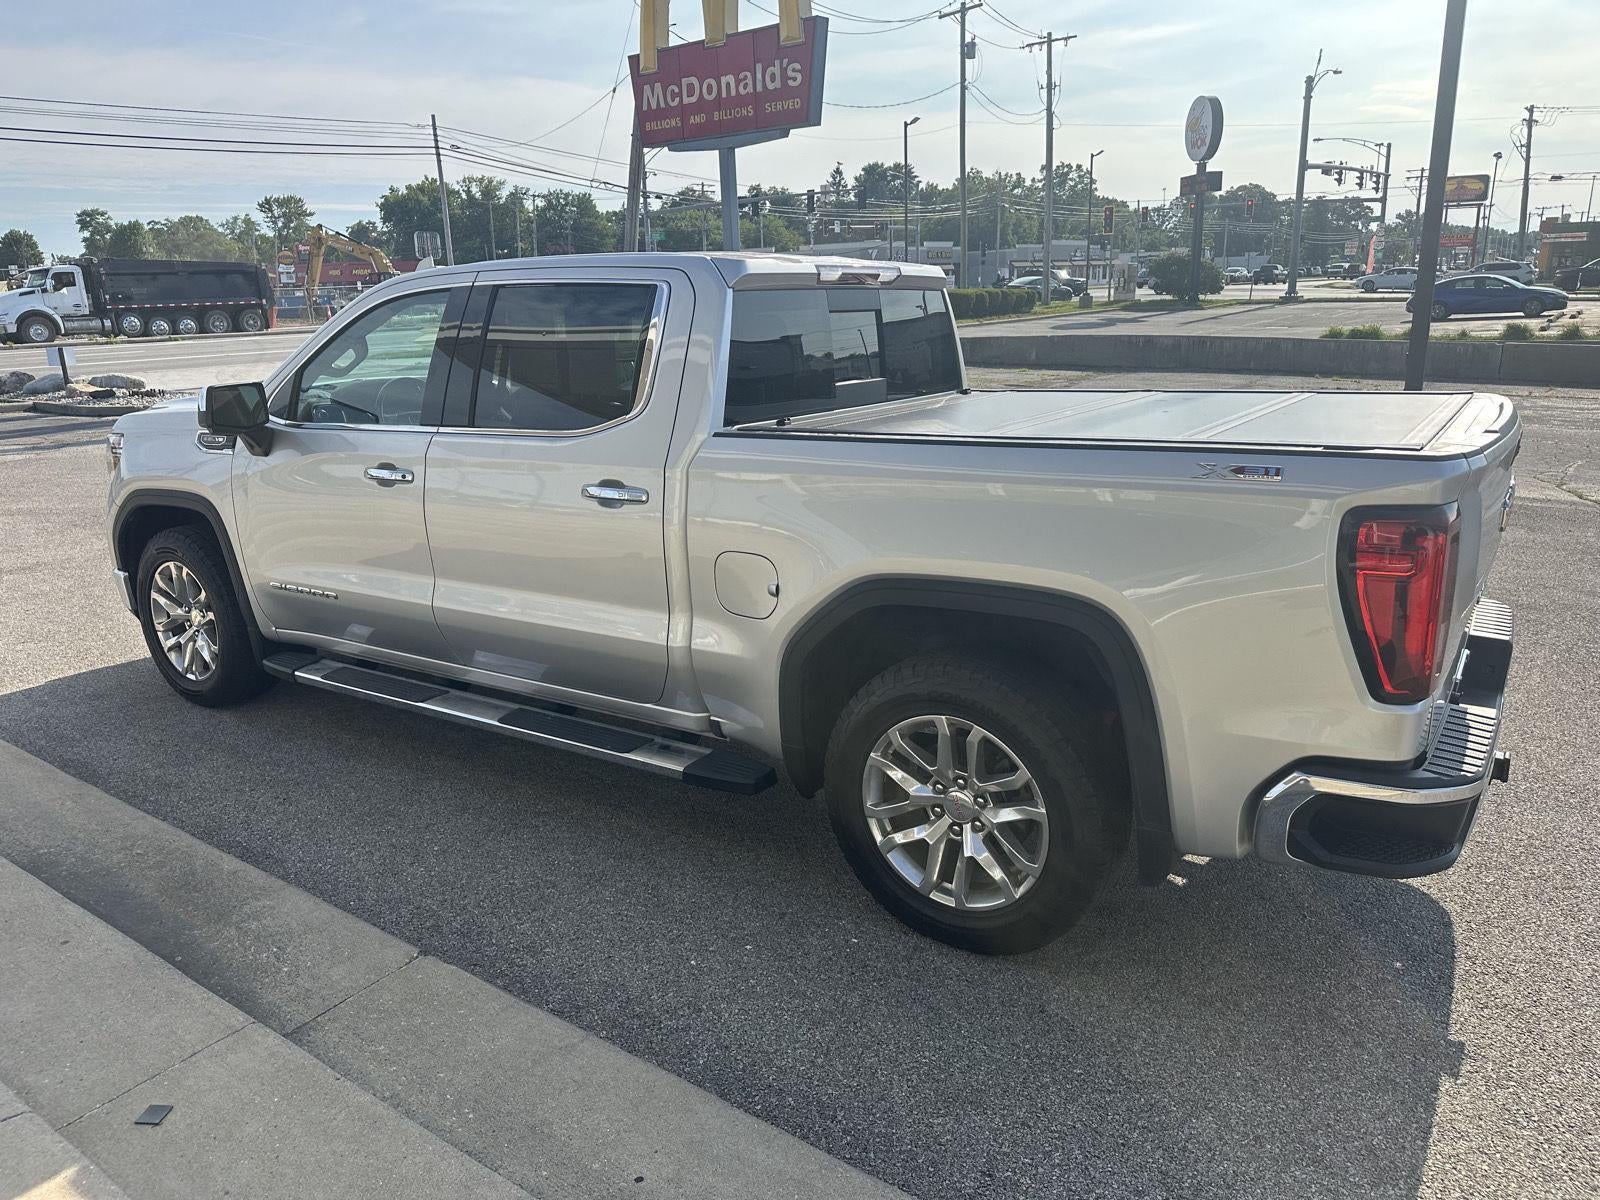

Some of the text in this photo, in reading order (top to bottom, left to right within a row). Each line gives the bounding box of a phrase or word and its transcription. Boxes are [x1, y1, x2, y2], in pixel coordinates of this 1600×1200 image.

[642, 58, 803, 111] McDonald's
[645, 98, 801, 131] BILLIONS AND BILLIONS SERVED
